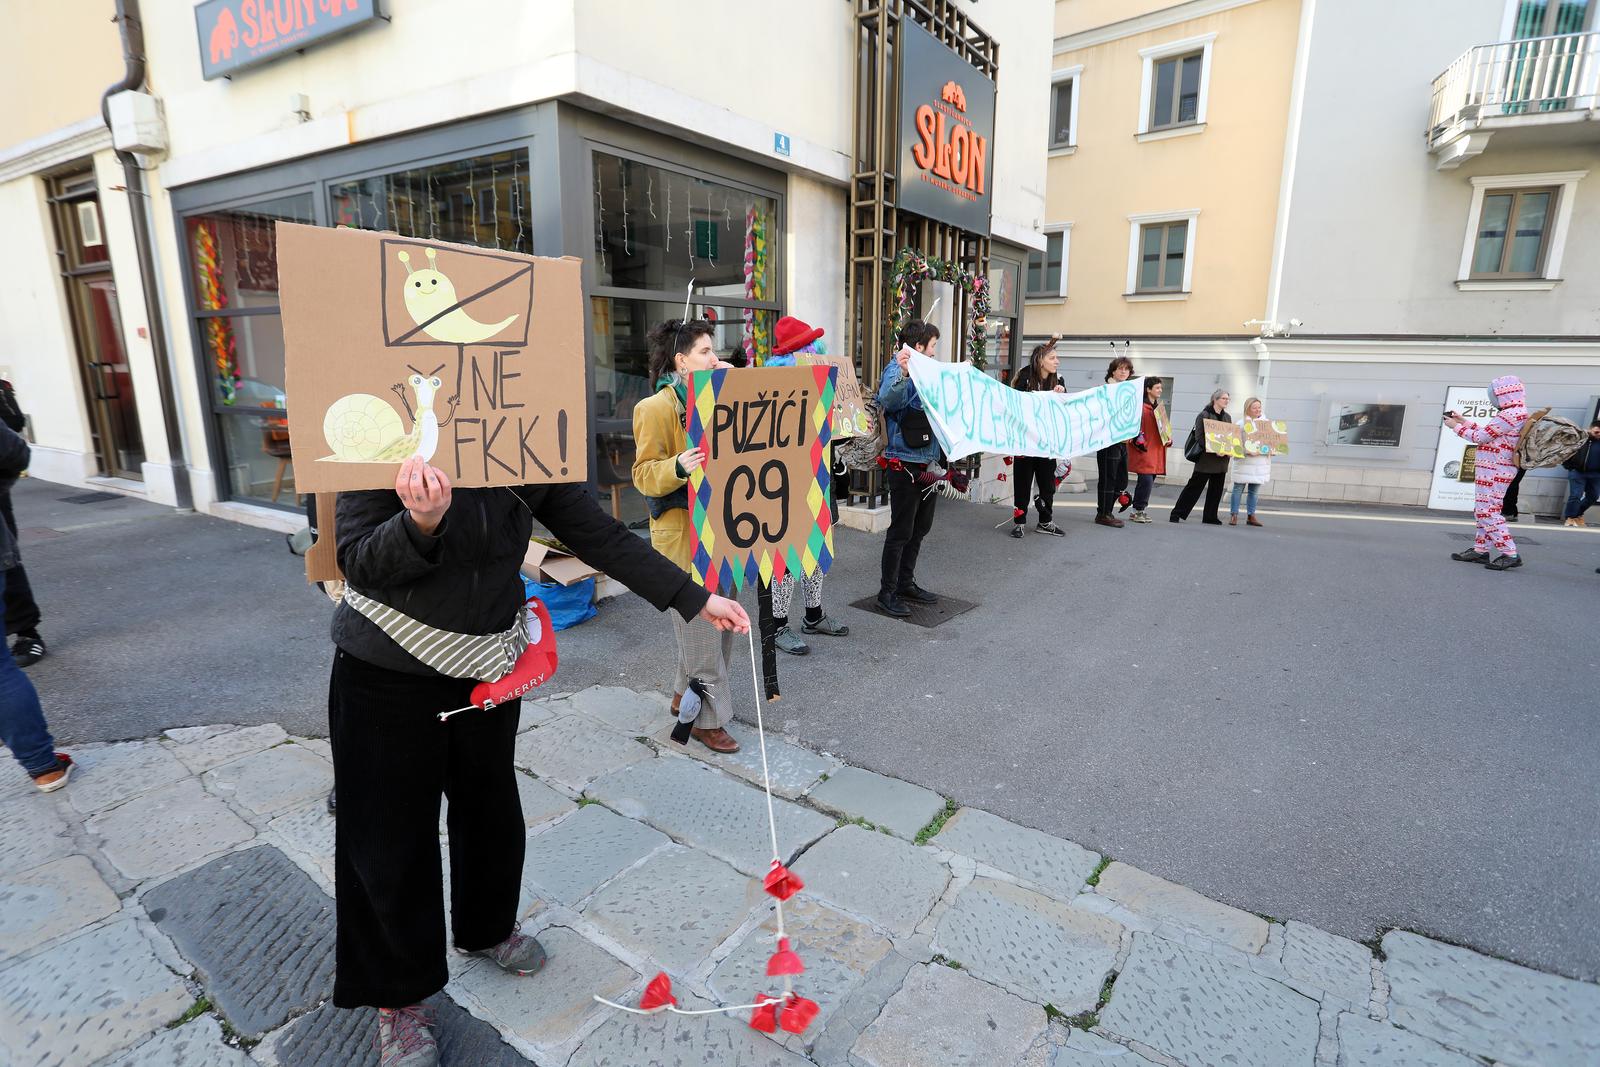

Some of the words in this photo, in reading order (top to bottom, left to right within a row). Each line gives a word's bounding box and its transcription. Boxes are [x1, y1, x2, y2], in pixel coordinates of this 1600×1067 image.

[779, 135, 786, 149] 4
[913, 104, 987, 195] SLON
[471, 350, 525, 411] NE
[1462, 405, 1501, 418] Zlat
[454, 409, 568, 482] FKK!
[723, 459, 789, 548] 69
[500, 673, 545, 702] MERRY
